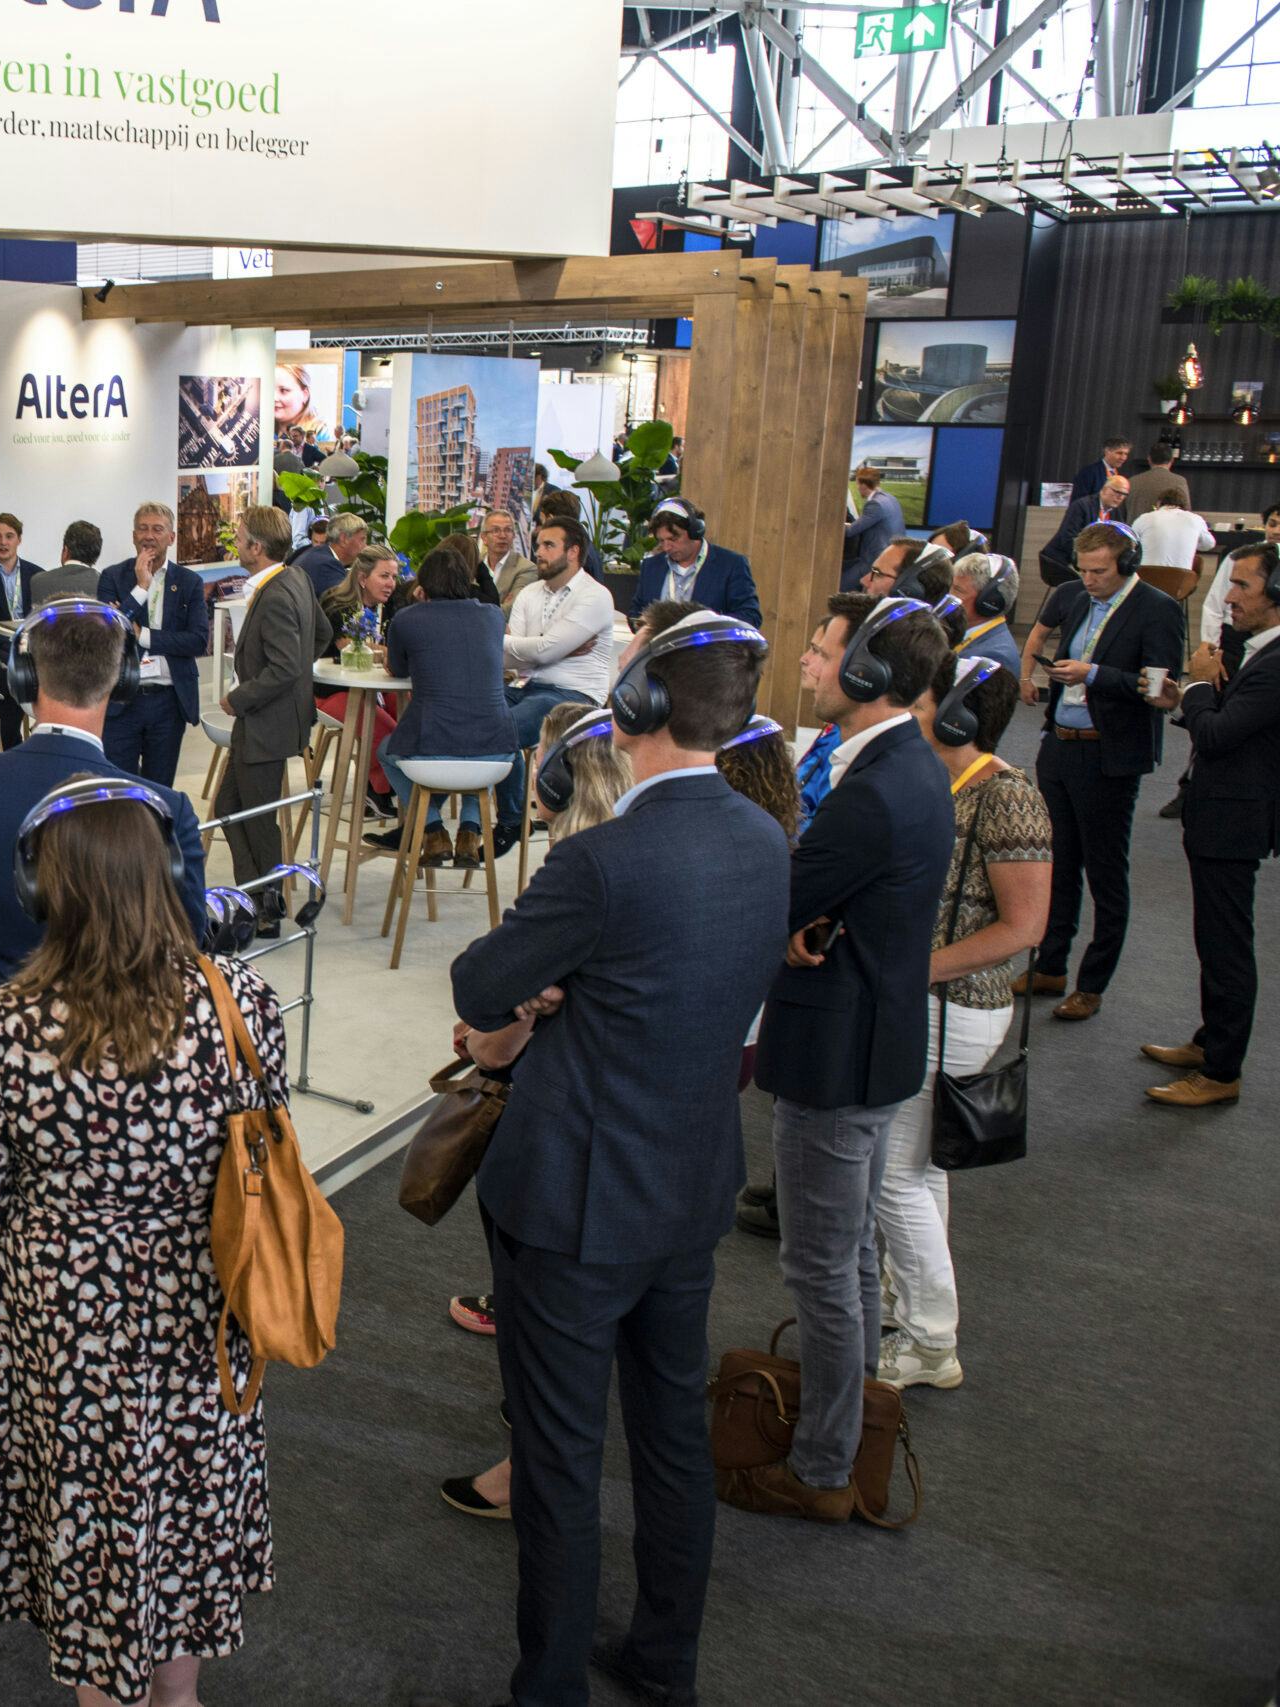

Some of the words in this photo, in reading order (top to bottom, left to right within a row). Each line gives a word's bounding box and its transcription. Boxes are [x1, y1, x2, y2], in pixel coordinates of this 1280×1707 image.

[64, 52, 102, 99] in
[113, 68, 281, 118] vastgoed
[50, 119, 189, 151] maatschappij
[196, 129, 219, 149] en
[226, 128, 309, 160] belegger
[15, 373, 128, 419] AlterA
[13, 432, 32, 445] Goed
[66, 432, 84, 446] goed
